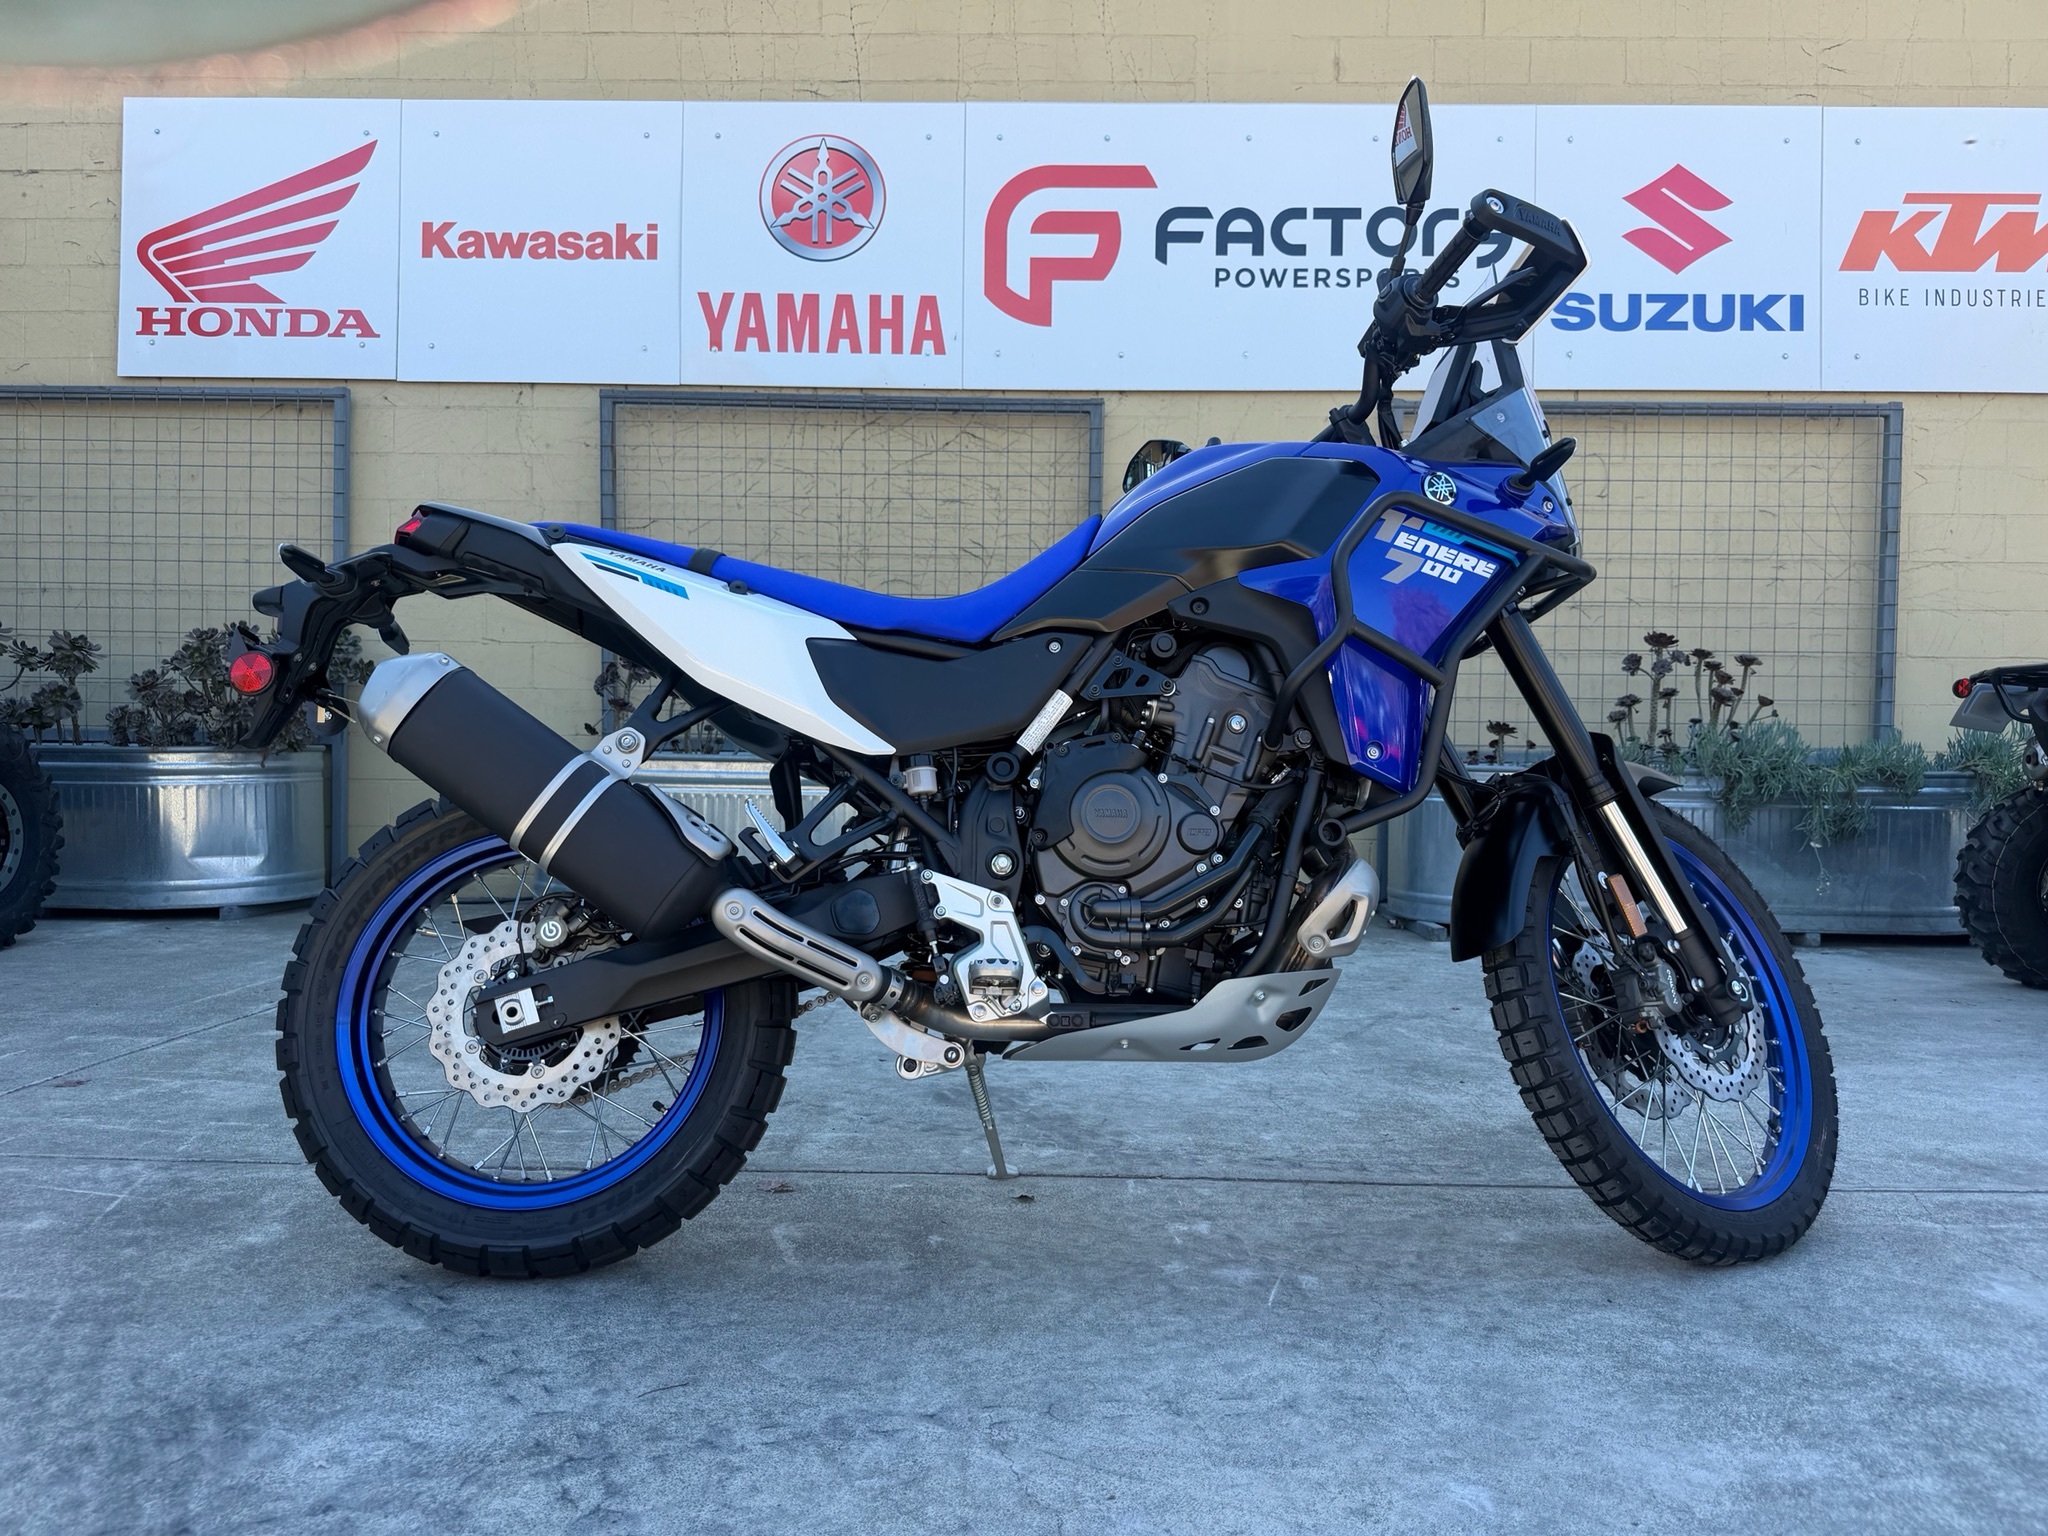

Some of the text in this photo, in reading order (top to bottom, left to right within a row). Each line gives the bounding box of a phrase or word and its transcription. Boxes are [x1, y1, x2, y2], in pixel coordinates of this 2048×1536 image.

[1519, 207, 1561, 237] YAMAHA
[1838, 192, 2048, 273] KTM
[421, 221, 658, 261] Kawasaki
[1214, 267, 1460, 288] POWERSPS
[1550, 292, 1804, 332] SUZUKI
[1859, 288, 2047, 308] BIKE INDUSTRIE
[135, 307, 381, 339] HONDA
[697, 291, 947, 356] YAMAHA
[608, 551, 667, 573] YAMAHA
[1381, 547, 1464, 585] 700
[1094, 808, 1129, 819] YAMAHA
